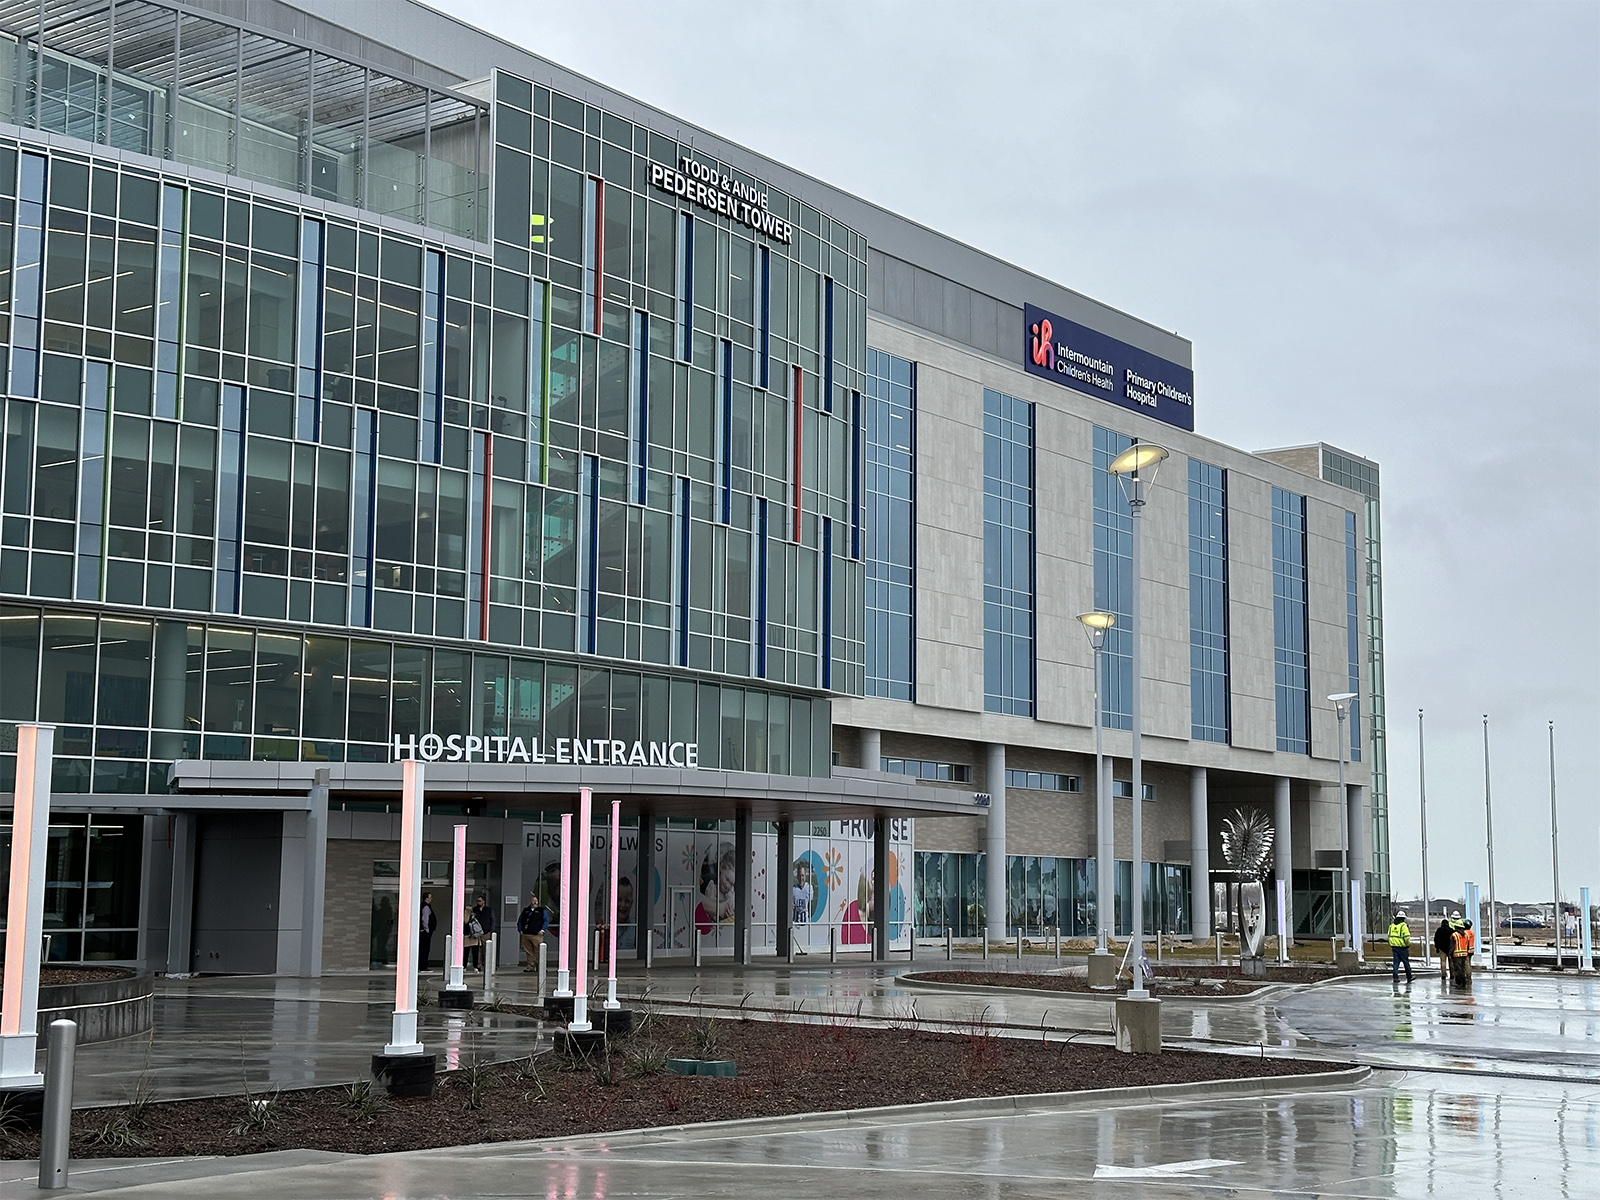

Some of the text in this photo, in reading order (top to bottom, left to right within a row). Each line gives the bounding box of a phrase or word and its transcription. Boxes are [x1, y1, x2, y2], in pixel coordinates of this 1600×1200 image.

[681, 156, 769, 210] TODD & ANDIE
[651, 164, 793, 244] PEDERSEN TOWER
[1057, 342, 1114, 376] Intermountain
[1057, 360, 1114, 392] Children's Health
[1126, 369, 1192, 406] Primary Children's
[1126, 384, 1158, 408] Hospital
[393, 733, 699, 768] HOSPITAL ENTRANCE
[526, 832, 664, 852] FIRS ND LWS
[840, 818, 909, 842] PROSE
